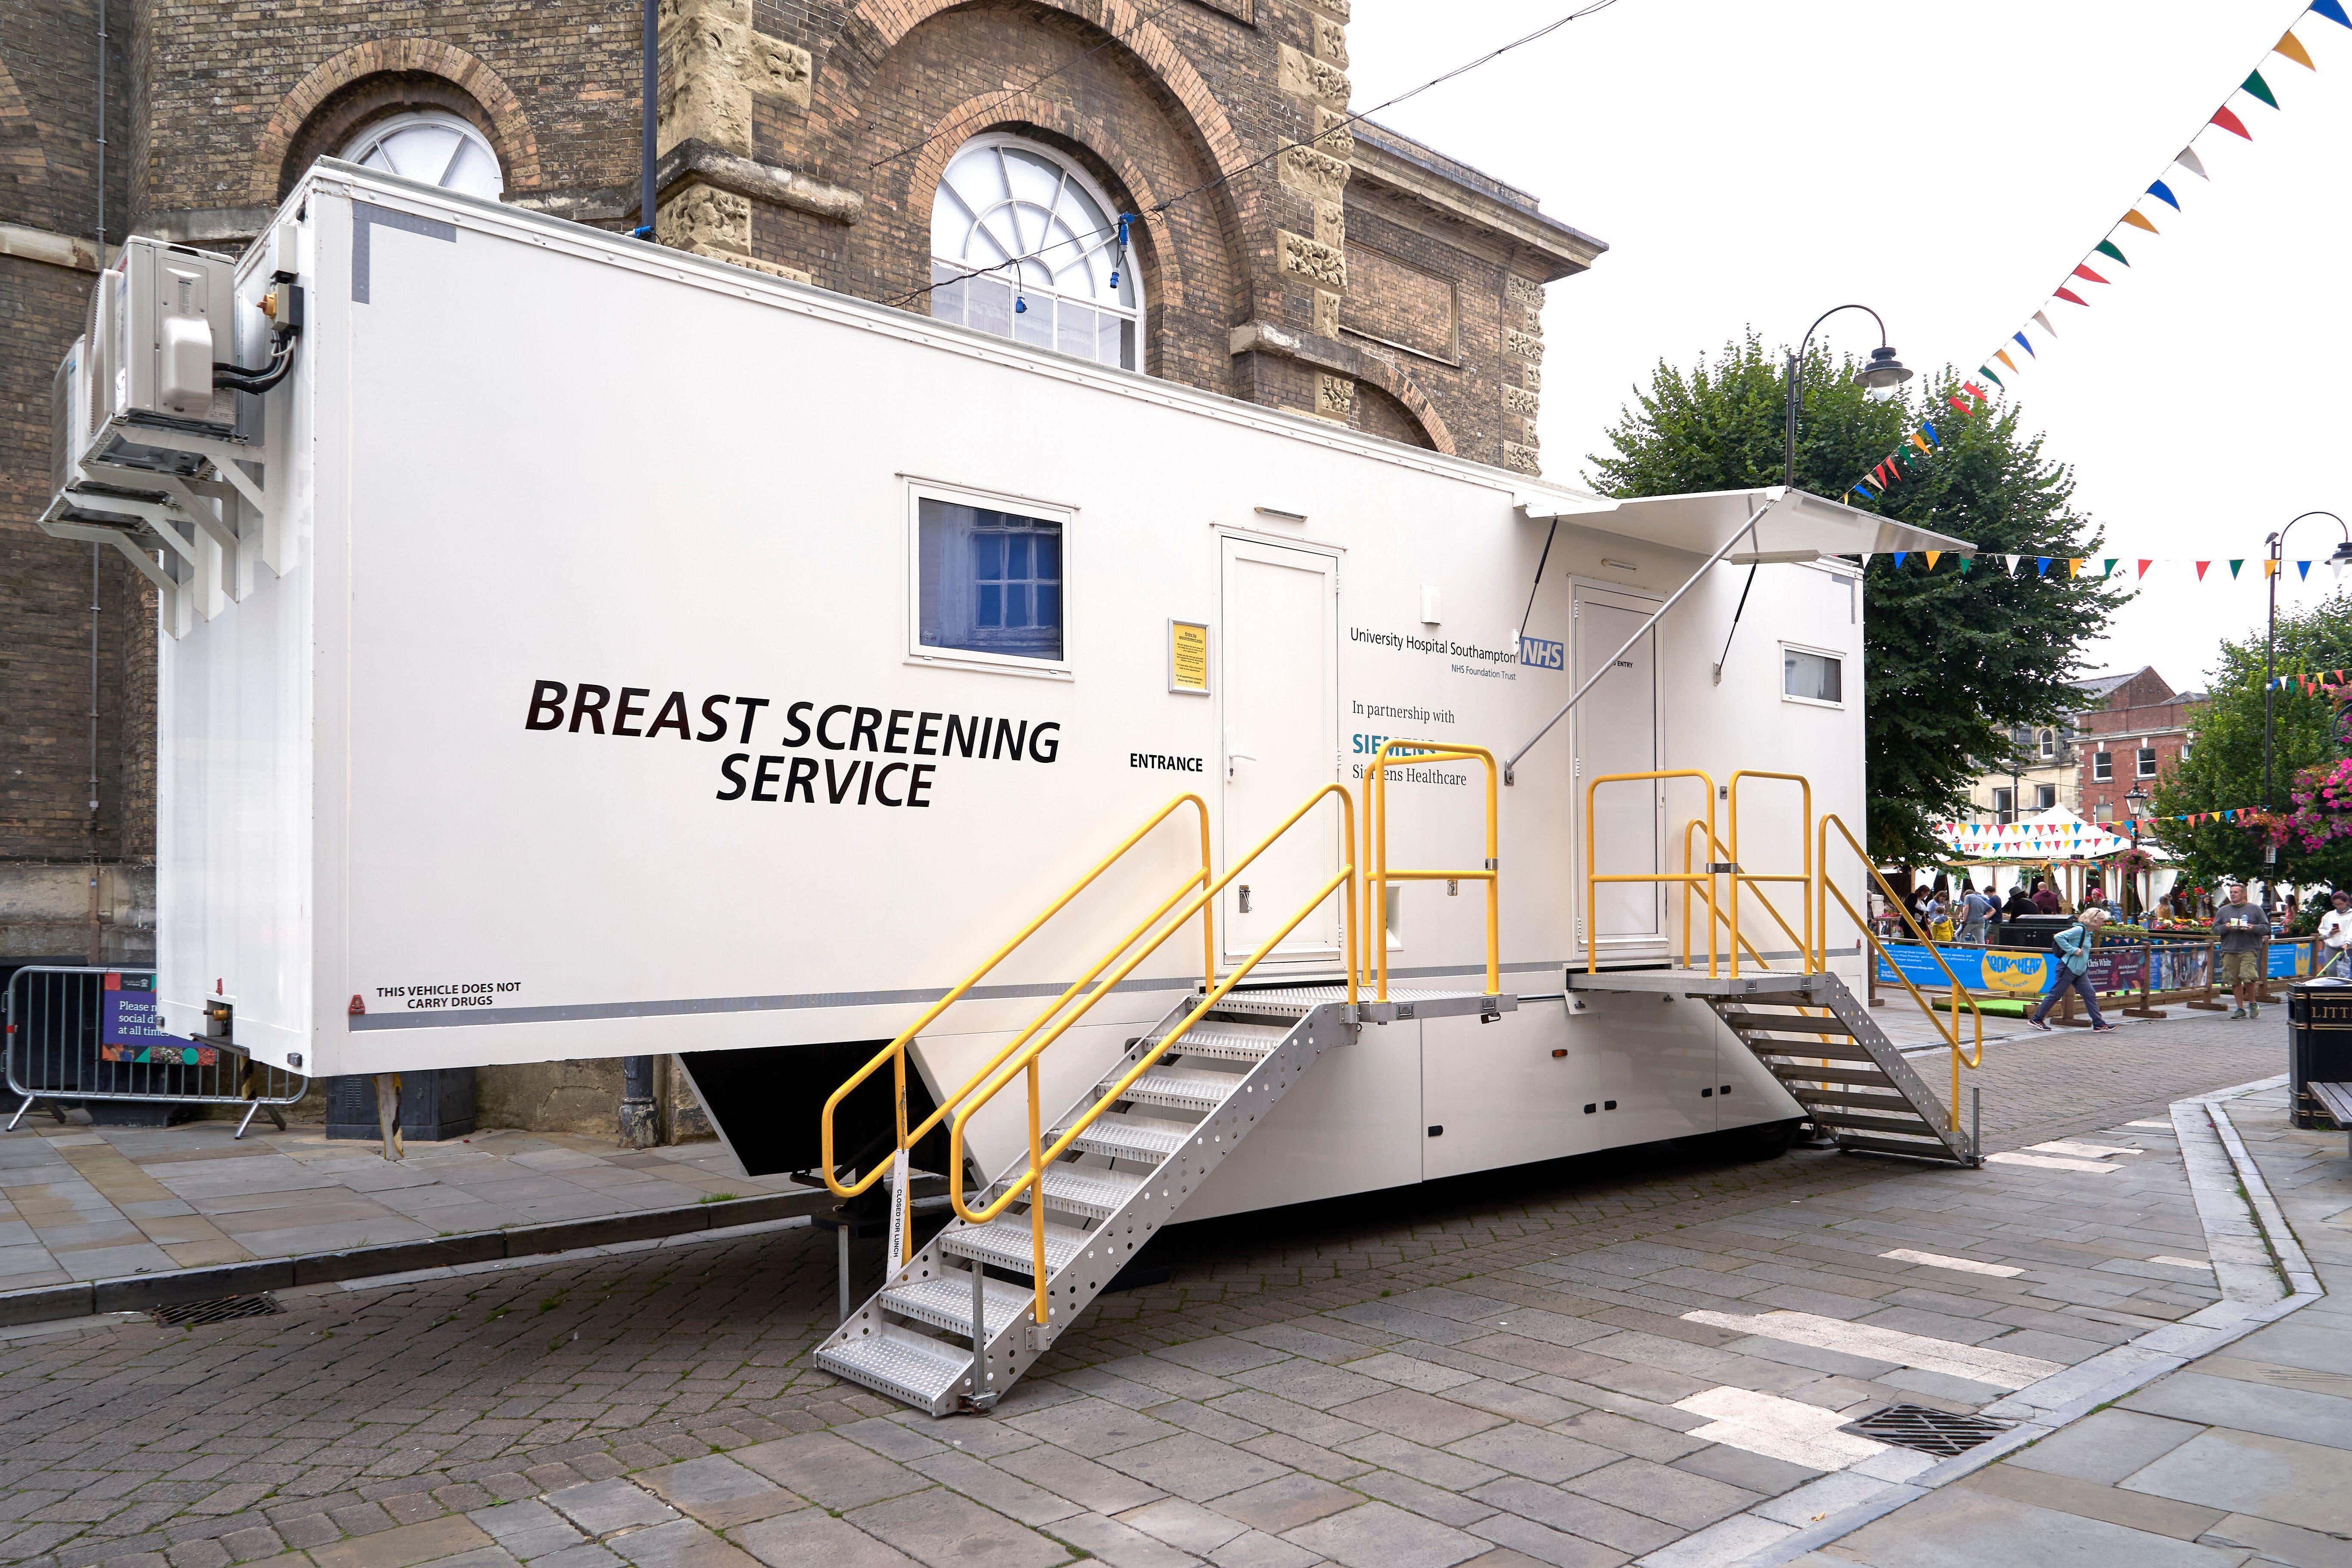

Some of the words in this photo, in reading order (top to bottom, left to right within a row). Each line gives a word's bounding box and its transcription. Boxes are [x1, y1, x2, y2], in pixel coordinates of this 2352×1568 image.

[1351, 628, 1403, 651] University
[1406, 636, 1447, 654] Hospital
[1450, 642, 1515, 664] Southampton
[1521, 639, 1562, 668] NHS
[1452, 664, 1465, 673] NHS
[1466, 666, 1500, 678] Foundation
[1501, 671, 1516, 681] Trust
[1353, 700, 1364, 714] In
[1367, 706, 1430, 724] partnership
[1433, 710, 1455, 723] with
[525, 680, 769, 744] BREAST
[782, 702, 1061, 763] SCREENING
[1130, 753, 1203, 772] ENTRANCE
[716, 753, 936, 807] SERVICE
[1353, 764, 1403, 781] Siens
[1406, 768, 1467, 786] Healthcare
[1986, 955, 2011, 973] LOOK
[2010, 958, 2043, 975] AHEAD
[2088, 958, 2098, 967] Chris
[2099, 958, 2112, 966] White
[376, 987, 405, 997] THIS
[408, 985, 459, 996] VEHICLE
[462, 983, 494, 994] DOES
[497, 982, 521, 992] NOT
[119, 1001, 149, 1011] Please
[408, 998, 448, 1009] CARRY
[451, 996, 493, 1007] DRUGS
[119, 1014, 146, 1024] social
[2312, 1007, 2352, 1018] LITT
[118, 1026, 128, 1034] at
[130, 1026, 141, 1035] all
